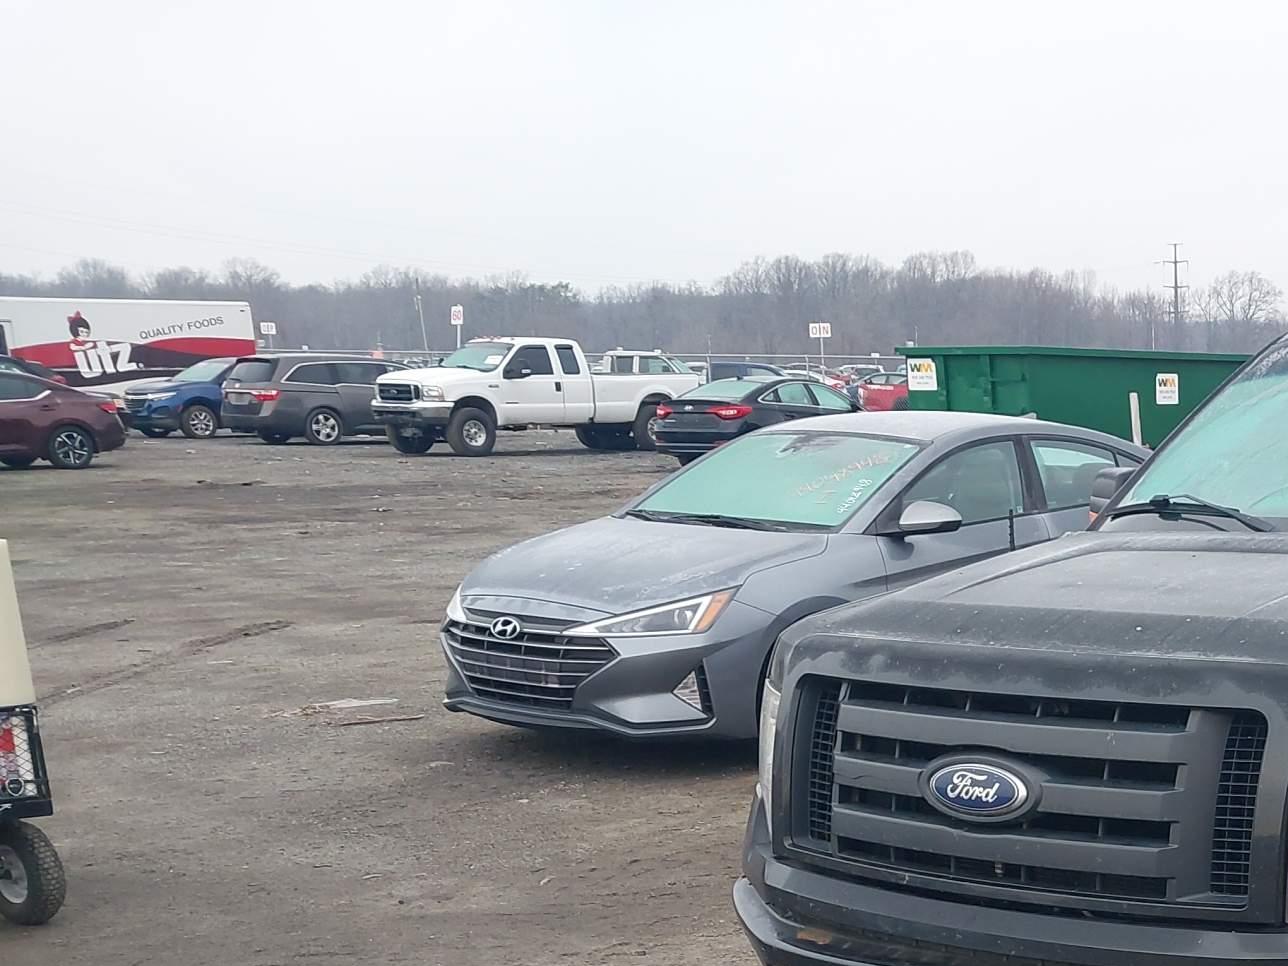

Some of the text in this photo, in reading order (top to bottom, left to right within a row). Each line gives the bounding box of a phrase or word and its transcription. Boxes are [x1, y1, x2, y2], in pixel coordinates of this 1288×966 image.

[139, 316, 225, 340] QUALITY FOODS
[910, 362, 933, 373] WM
[946, 771, 1001, 803] Ford
